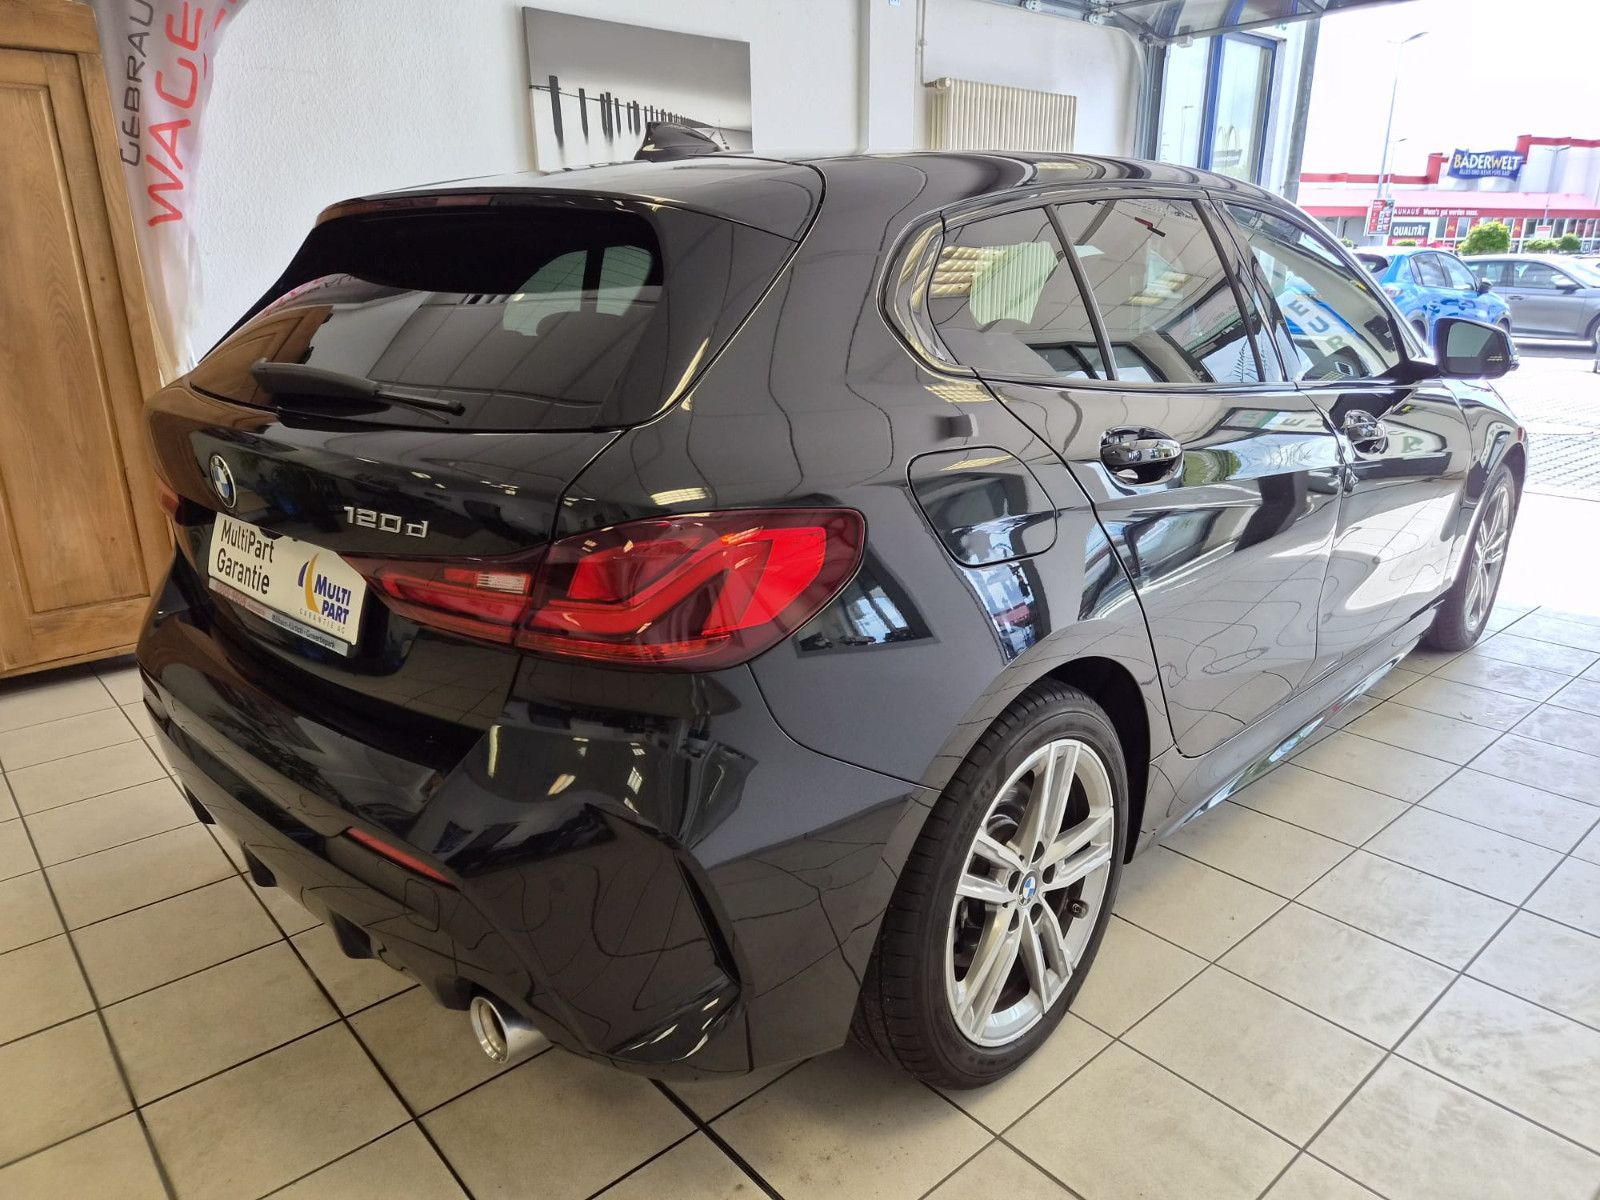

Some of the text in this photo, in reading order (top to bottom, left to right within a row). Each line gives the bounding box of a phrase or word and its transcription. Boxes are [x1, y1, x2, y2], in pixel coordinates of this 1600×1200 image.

[1453, 150, 1521, 170] BÄDERWELT
[1394, 207, 1420, 215] AUHAUS
[1393, 224, 1426, 236] QUALITÄT
[220, 519, 275, 563] MultiPart
[217, 547, 270, 595] Garantie
[321, 602, 349, 625] PART
